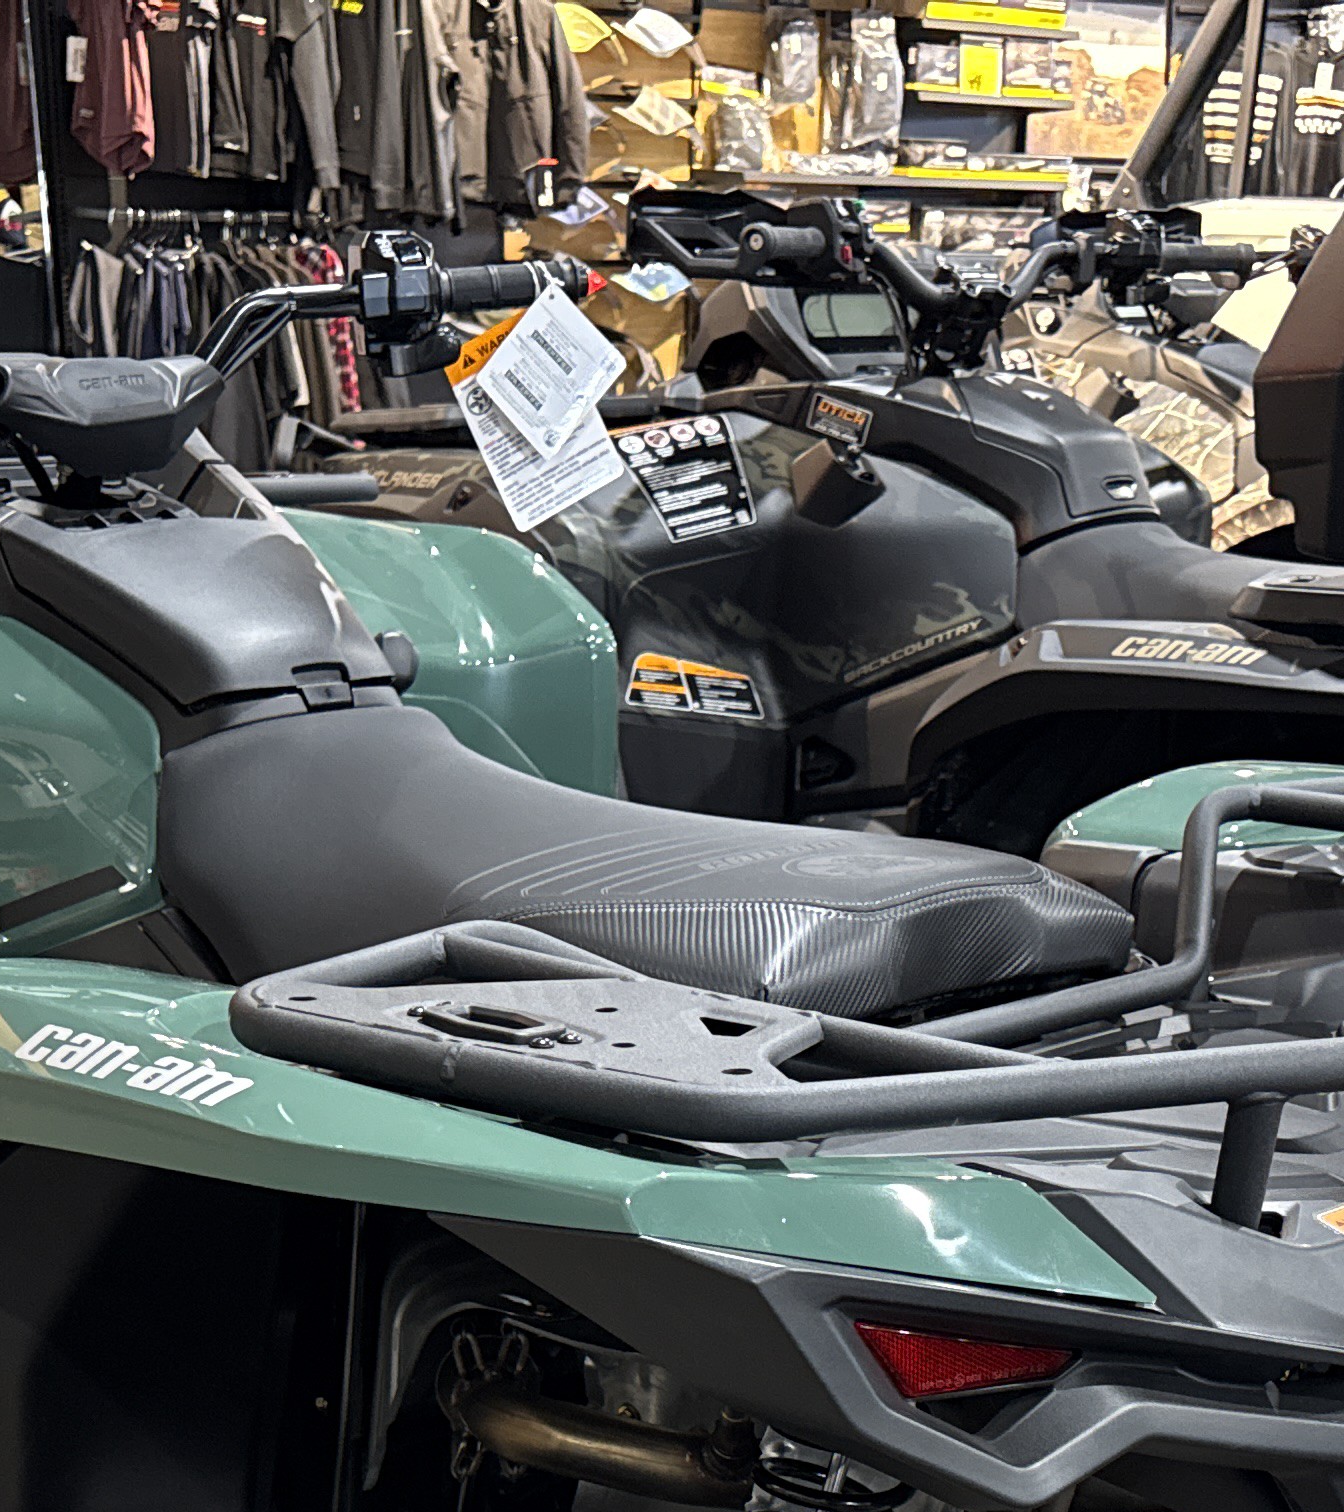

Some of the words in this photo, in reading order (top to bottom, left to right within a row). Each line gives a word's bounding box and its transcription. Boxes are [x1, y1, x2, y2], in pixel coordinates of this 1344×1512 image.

[844, 618, 984, 684] BACKCOUNTRY
[1111, 636, 1268, 666] can-am
[14, 1023, 255, 1107] can-am
